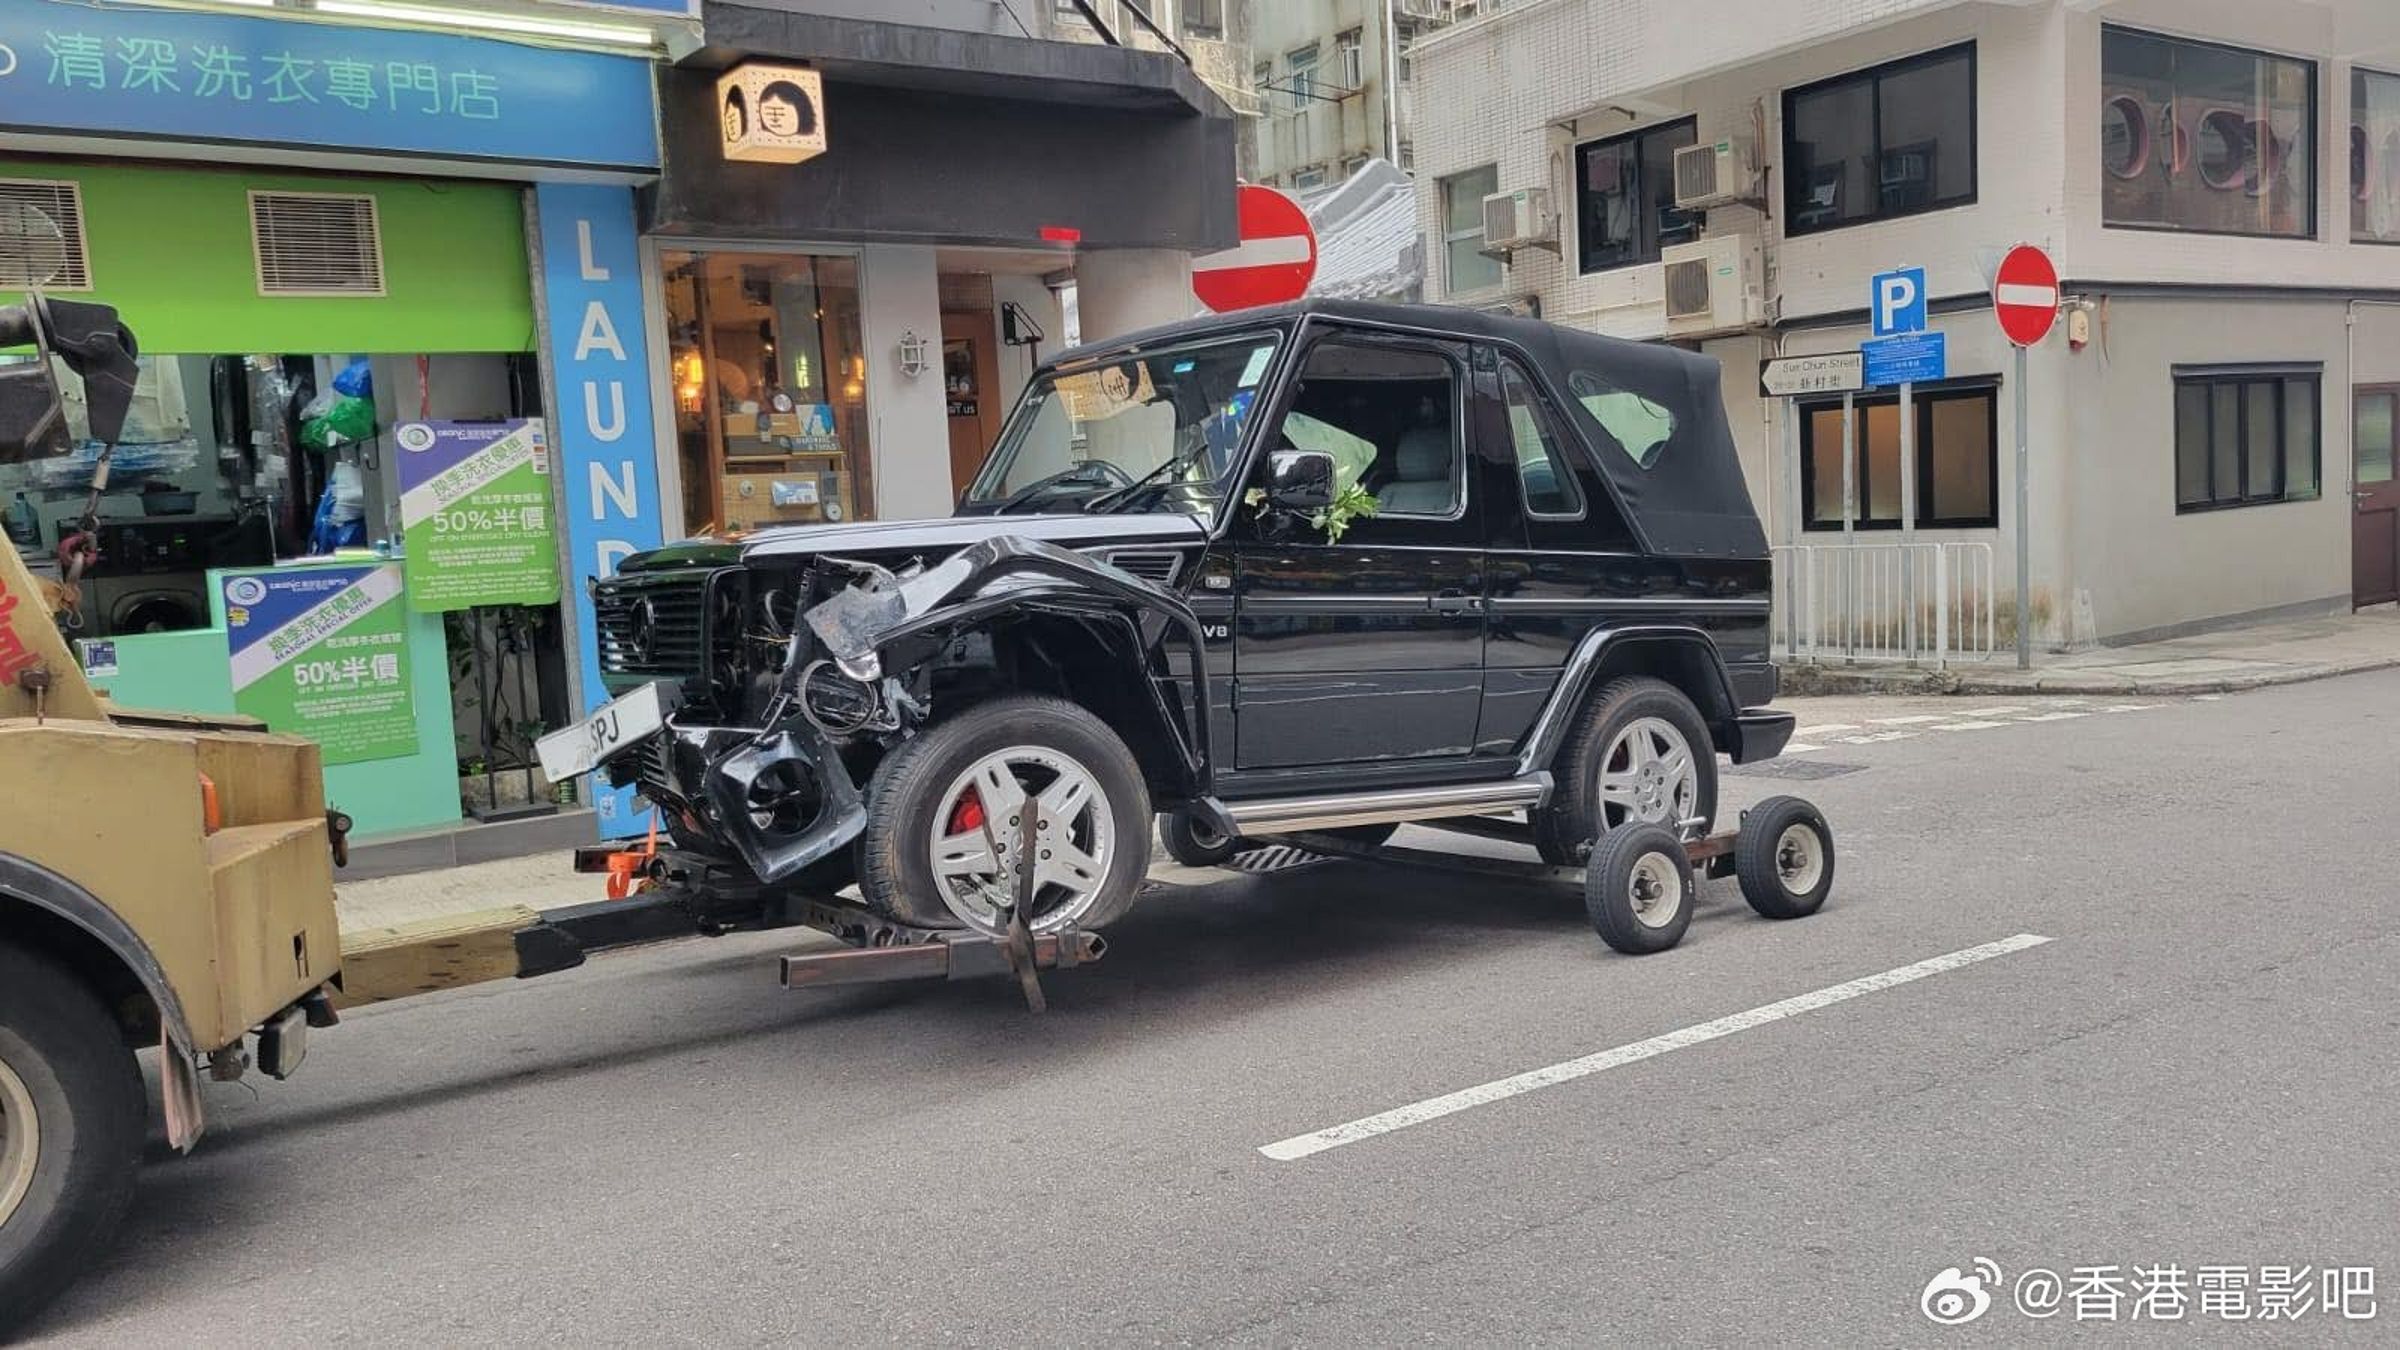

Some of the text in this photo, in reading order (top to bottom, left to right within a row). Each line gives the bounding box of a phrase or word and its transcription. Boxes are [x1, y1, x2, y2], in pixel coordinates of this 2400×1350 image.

[44, 29, 500, 120] 清深洗衣專門店
[1881, 277, 1915, 330] P
[1783, 355, 1860, 373] Sun Chun Street
[433, 506, 546, 533] 50%半價
[293, 653, 400, 686] 50%半價
